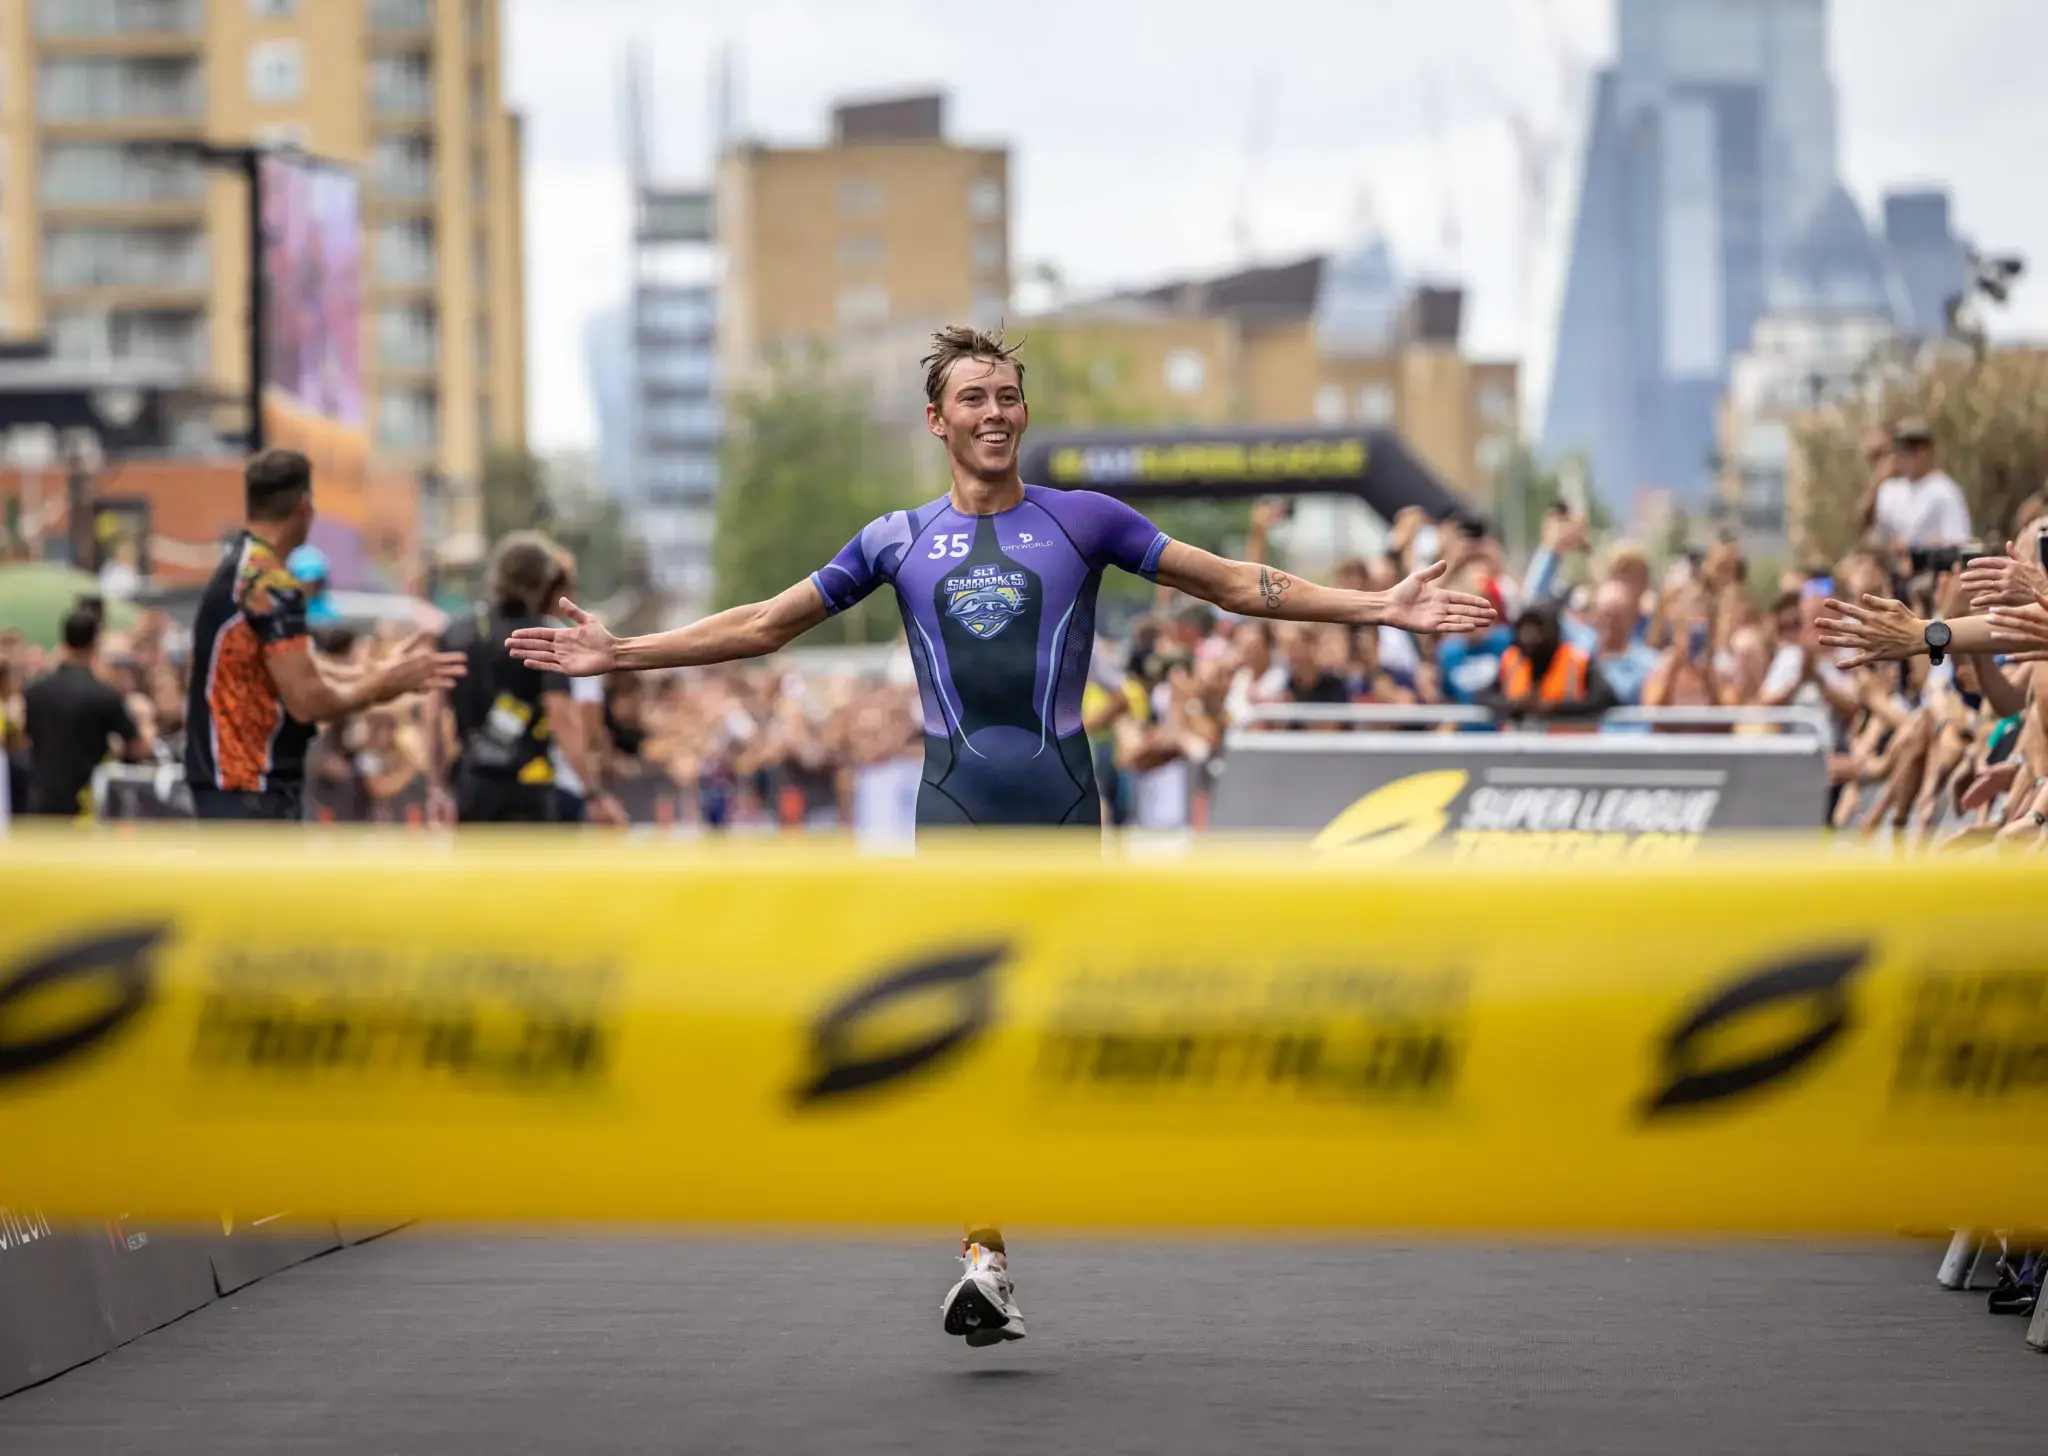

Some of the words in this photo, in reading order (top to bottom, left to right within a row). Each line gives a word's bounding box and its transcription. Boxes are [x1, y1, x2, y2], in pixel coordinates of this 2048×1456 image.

[927, 533, 970, 560] 35
[1001, 540, 1054, 552] DRYWORLD
[973, 567, 996, 577] SLT
[946, 573, 1025, 592] SHARKS
[1461, 786, 1582, 831] SUPER
[1575, 788, 1721, 833] LEAGUE
